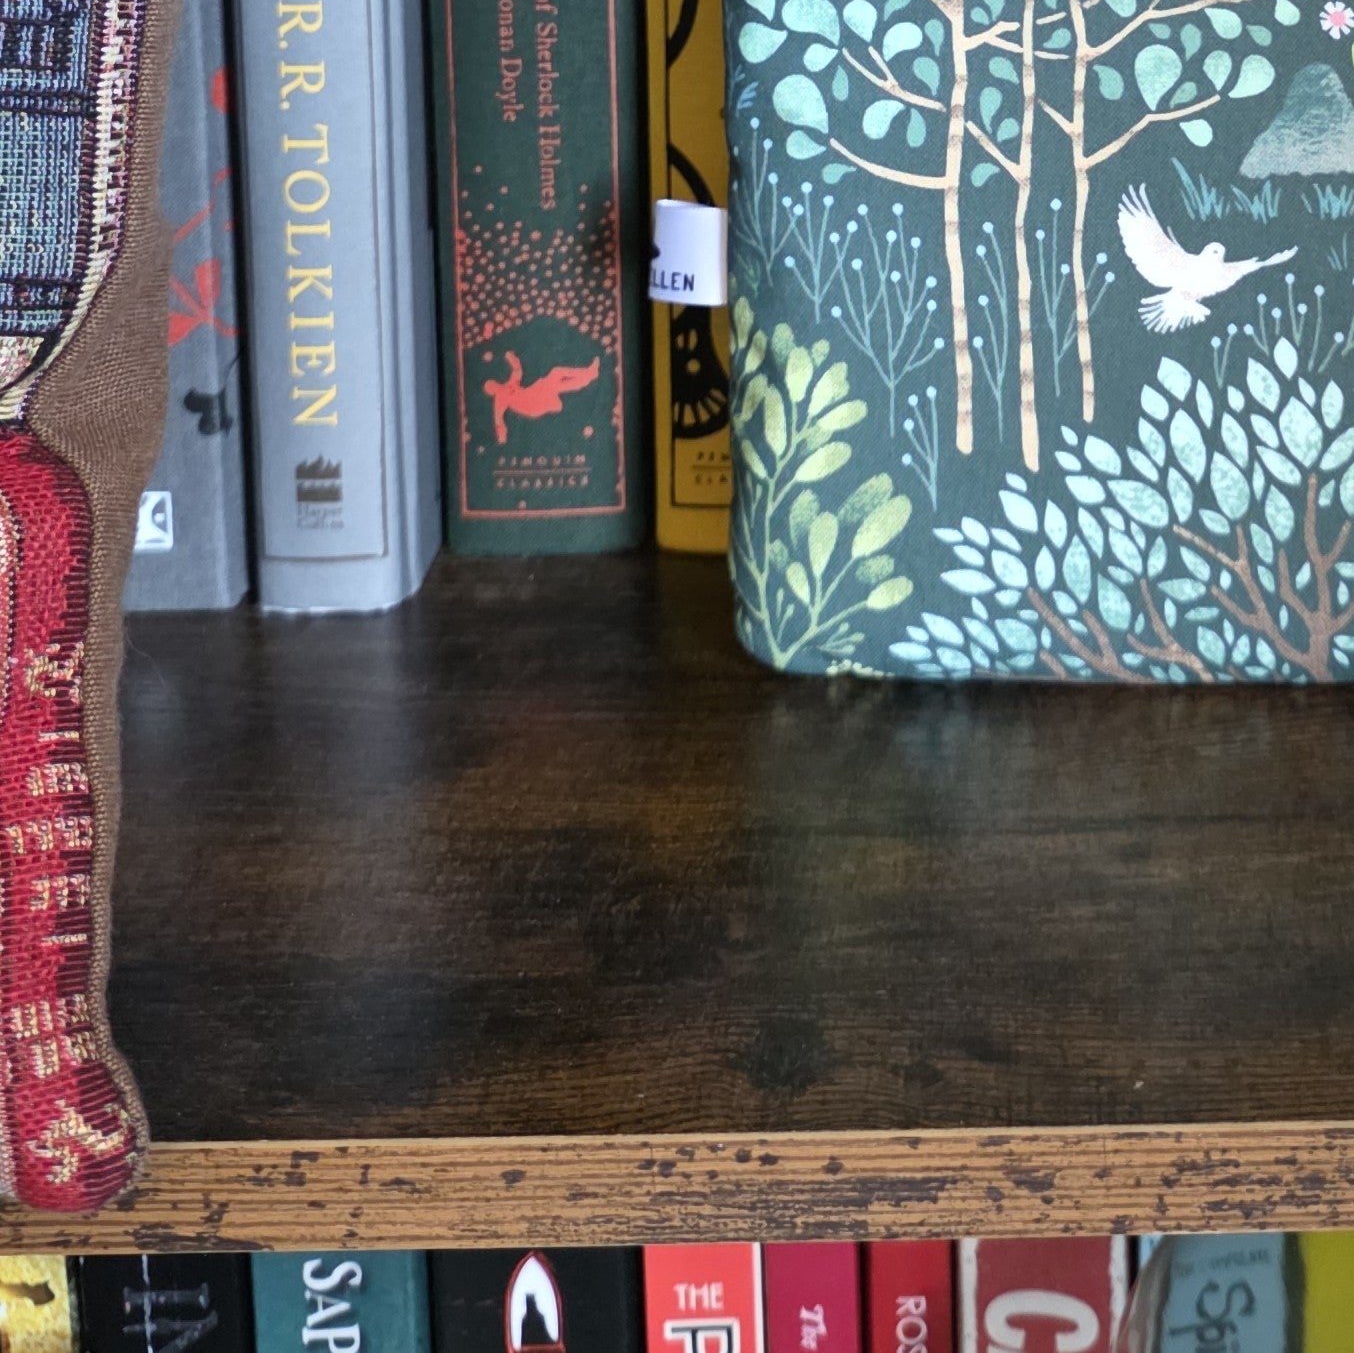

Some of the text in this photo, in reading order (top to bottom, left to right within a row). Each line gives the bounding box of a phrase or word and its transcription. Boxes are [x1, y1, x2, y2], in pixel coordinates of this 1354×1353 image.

[495, 57, 524, 123] Doyle
[535, 22, 560, 118] Sherlock
[538, 124, 562, 210] Holmes
[281, 123, 338, 427] TOLKIEN
[302, 1257, 362, 1353] SAP
[673, 1282, 724, 1310] THE
